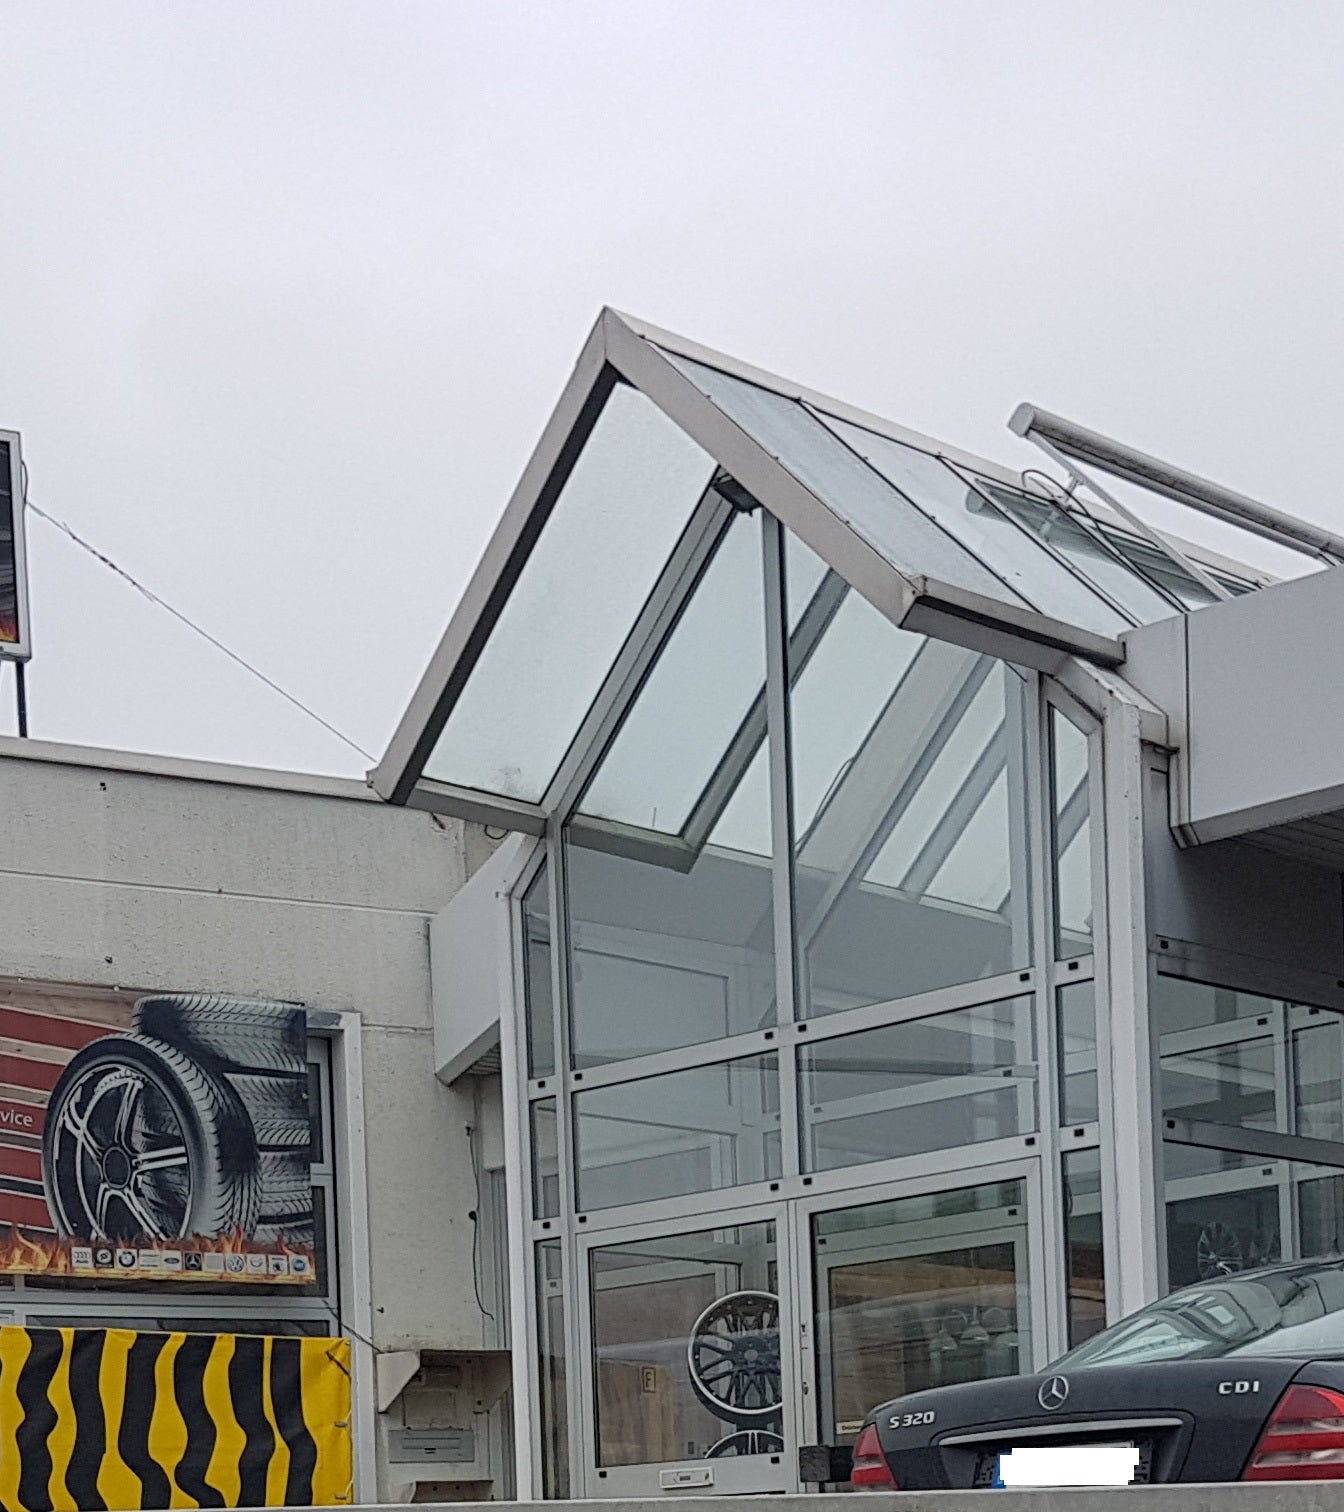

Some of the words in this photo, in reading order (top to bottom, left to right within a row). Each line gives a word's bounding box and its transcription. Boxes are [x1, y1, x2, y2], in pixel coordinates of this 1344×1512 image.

[1217, 1379, 1261, 1396] CDI
[889, 1416, 900, 1429] S
[901, 1410, 935, 1428] 320
